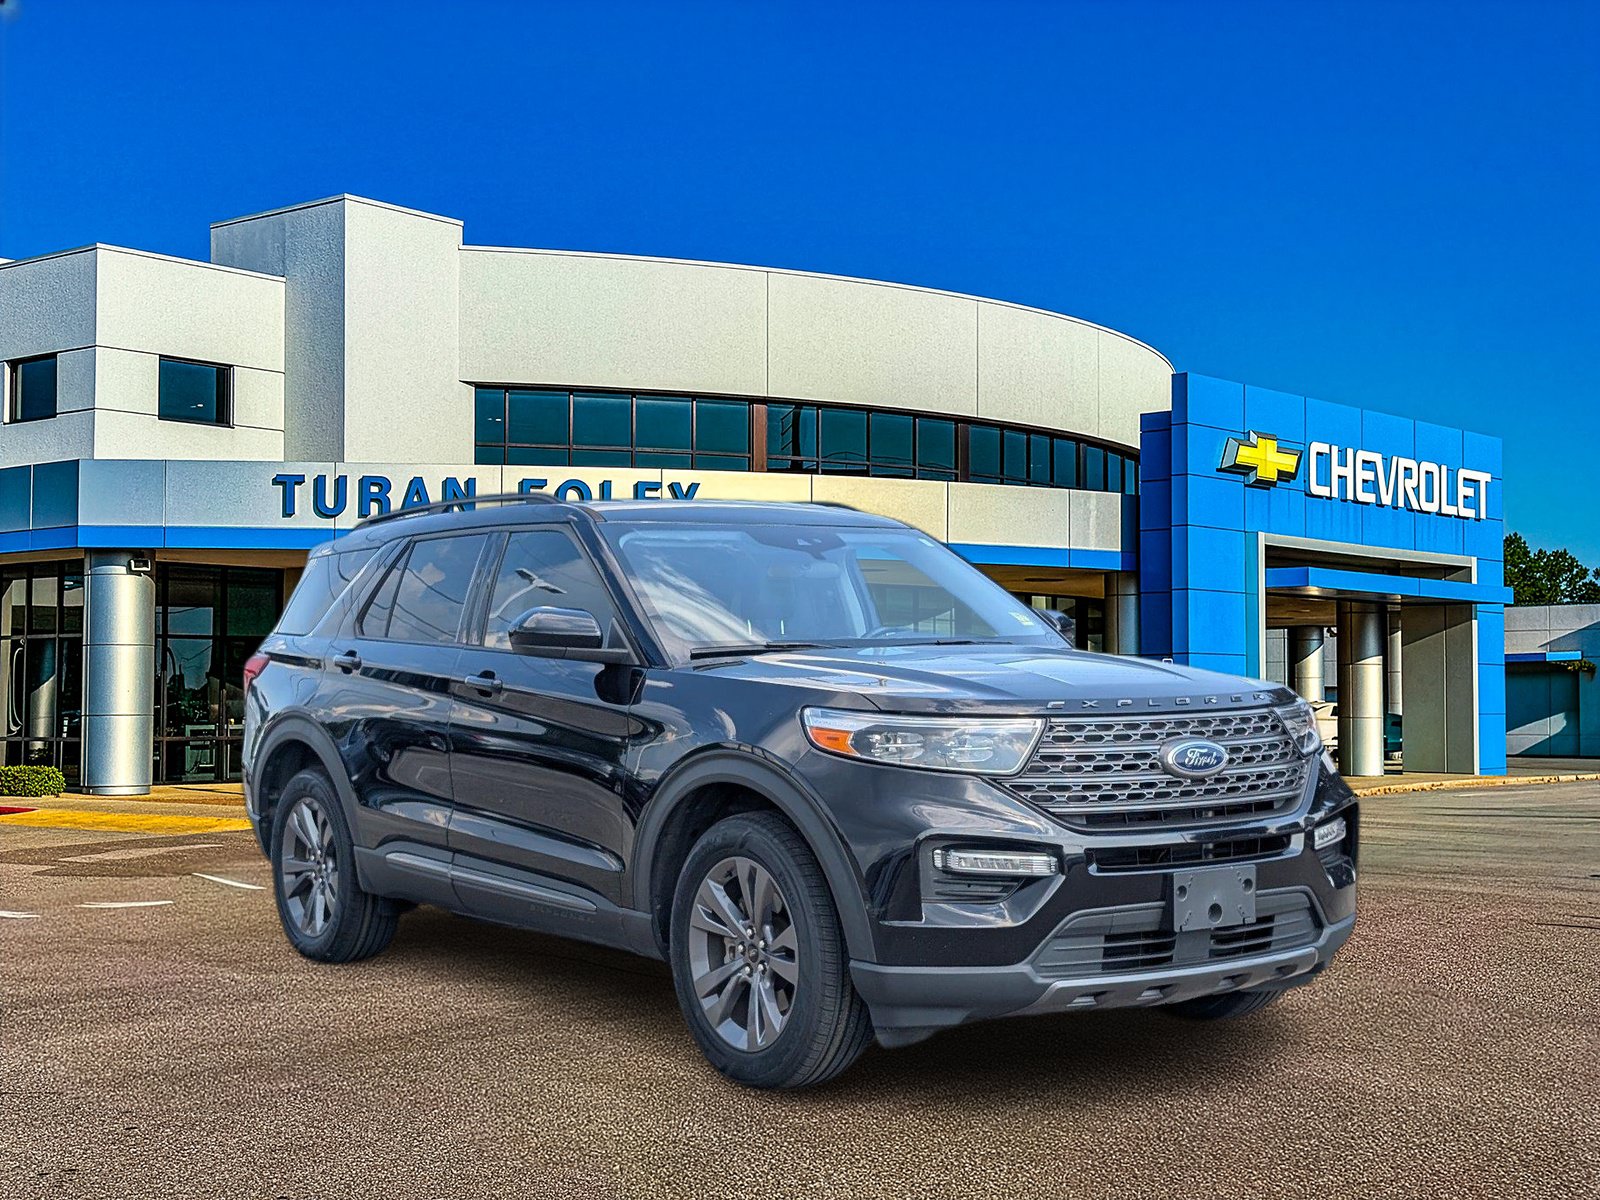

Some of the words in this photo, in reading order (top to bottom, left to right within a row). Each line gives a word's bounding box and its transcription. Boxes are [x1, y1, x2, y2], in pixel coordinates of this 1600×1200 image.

[272, 474, 477, 518] TURAN
[1309, 441, 1491, 519] CHEVROLET
[1046, 693, 1267, 709] EXPLORER
